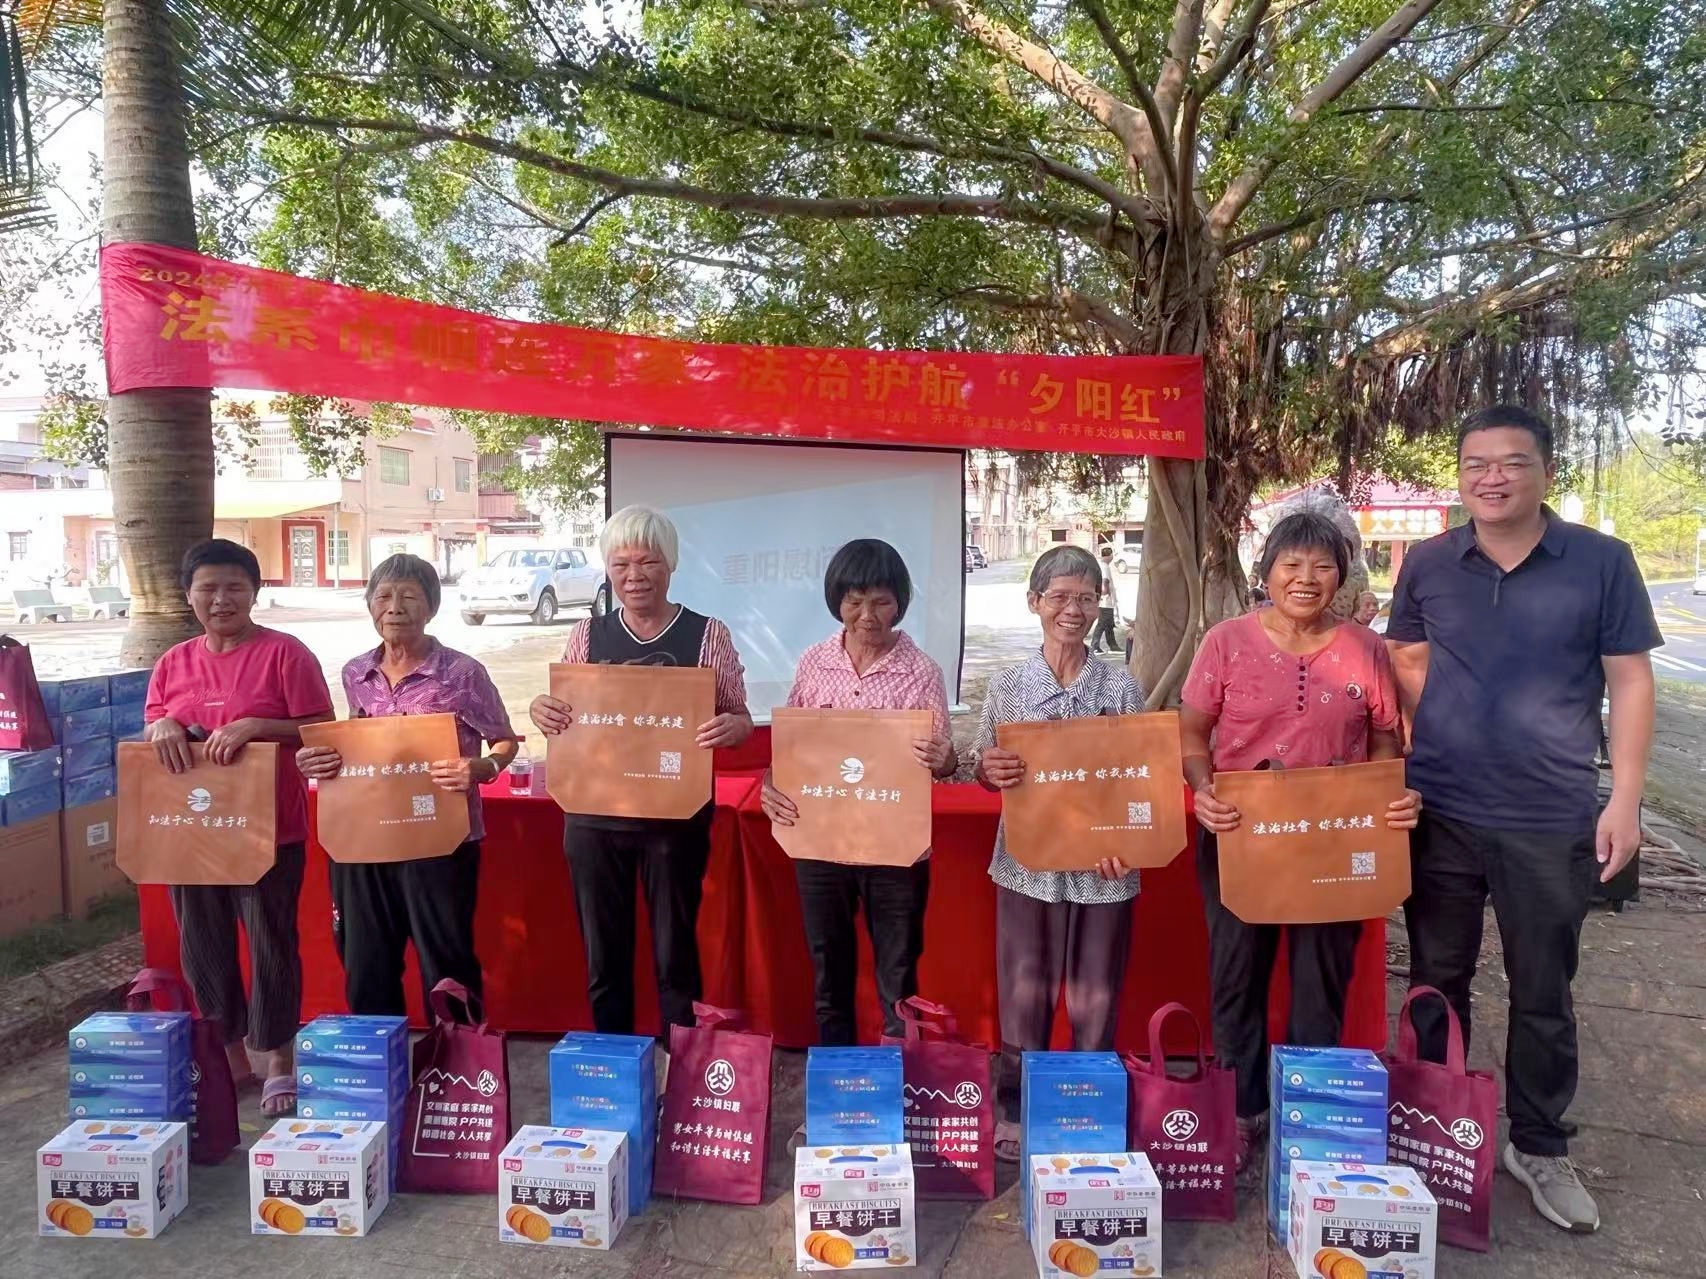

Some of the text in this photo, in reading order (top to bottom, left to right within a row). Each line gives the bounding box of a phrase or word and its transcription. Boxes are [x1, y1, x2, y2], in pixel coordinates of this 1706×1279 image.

[691, 1096, 741, 1113] 大沙镇妇联
[459, 1117, 493, 1128] 户户共建
[941, 1117, 979, 1127] 家家共创
[941, 1131, 979, 1141] 户户共建
[941, 1143, 979, 1153] 人人共享
[1433, 1145, 1476, 1170] 家家共创
[1432, 1160, 1474, 1183] 户户共建
[56, 1181, 135, 1198] 早餐饼干
[268, 1181, 345, 1197] 早餐饼干
[515, 1187, 591, 1207] 早餐饼干
[814, 1209, 897, 1228] 早餐饼干
[1060, 1218, 1143, 1237] 早餐饼干
[1327, 1229, 1415, 1250] 早餐饼干
